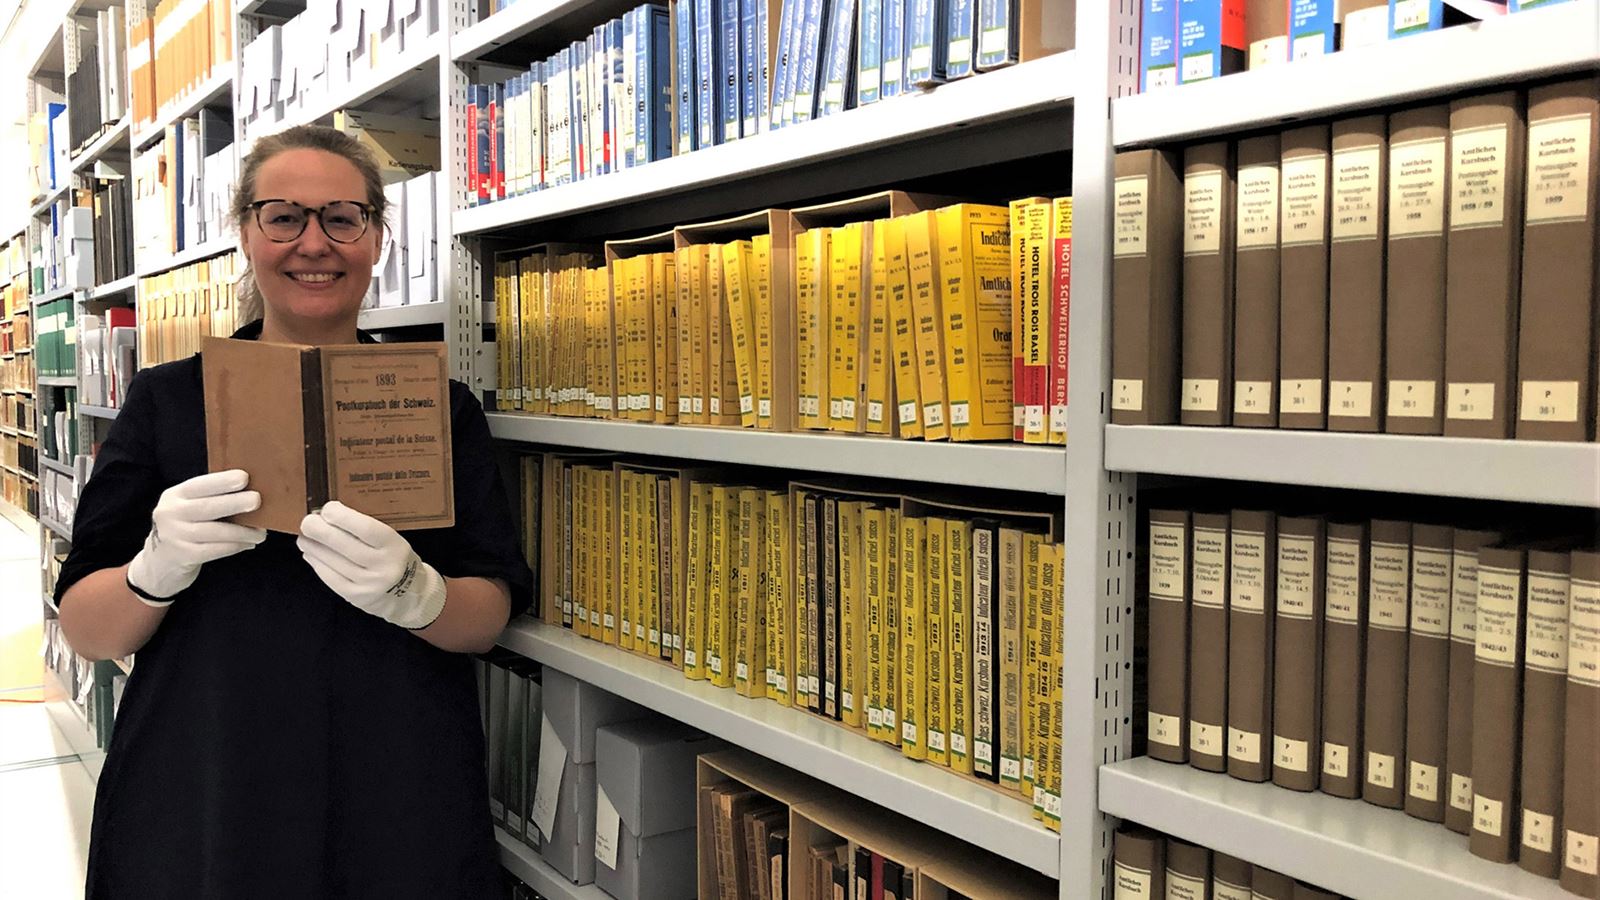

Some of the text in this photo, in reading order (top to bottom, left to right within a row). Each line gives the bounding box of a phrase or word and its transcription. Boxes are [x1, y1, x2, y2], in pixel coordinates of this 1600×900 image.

[1462, 146, 1496, 156] Amtliches
[1539, 146, 1576, 157] Kursbuch
[1540, 137, 1576, 147] Amtliches
[1461, 155, 1496, 165] Kursbuch
[1466, 179, 1488, 187] Winter
[1032, 246, 1040, 278] HOTEL
[1061, 244, 1070, 280] HOTEL
[1031, 309, 1039, 334] ROIS
[1058, 284, 1069, 370] SCHWEIZERHOF
[1030, 335, 1038, 364] BASEL
[376, 373, 396, 386] 1893
[404, 398, 436, 408] Schweiz.
[1056, 378, 1065, 406] BERN
[397, 434, 404, 443] de
[930, 534, 940, 555] suisse
[952, 530, 961, 552] suisse
[978, 532, 988, 555] suisse
[930, 556, 940, 580] officiel
[952, 552, 961, 577] officiel
[977, 556, 988, 582] officiel
[1041, 563, 1054, 586] suisse
[952, 579, 962, 614] Indicateur
[1480, 590, 1514, 600] Kursbuch
[1481, 581, 1514, 592] Amtliches
[1532, 586, 1566, 596] Amtliches
[930, 582, 940, 616] Indicateur
[977, 583, 989, 618] Indicateur
[1040, 588, 1052, 616] officiel
[1531, 594, 1566, 605] Kursbuch
[980, 622, 986, 632] 14
[1484, 616, 1506, 624] Winter
[1039, 618, 1052, 656] Indicateur
[1481, 642, 1507, 652] 1942/43
[1532, 648, 1560, 659] 1942/43
[930, 650, 940, 684] Kursbuch
[953, 652, 963, 685] Kursbuch
[978, 659, 989, 694] Kursbuch
[1041, 661, 1048, 672] 15
[978, 695, 990, 724] schweiz.
[1037, 702, 1050, 739] Kursbuch
[1037, 741, 1048, 772] schweiz.
